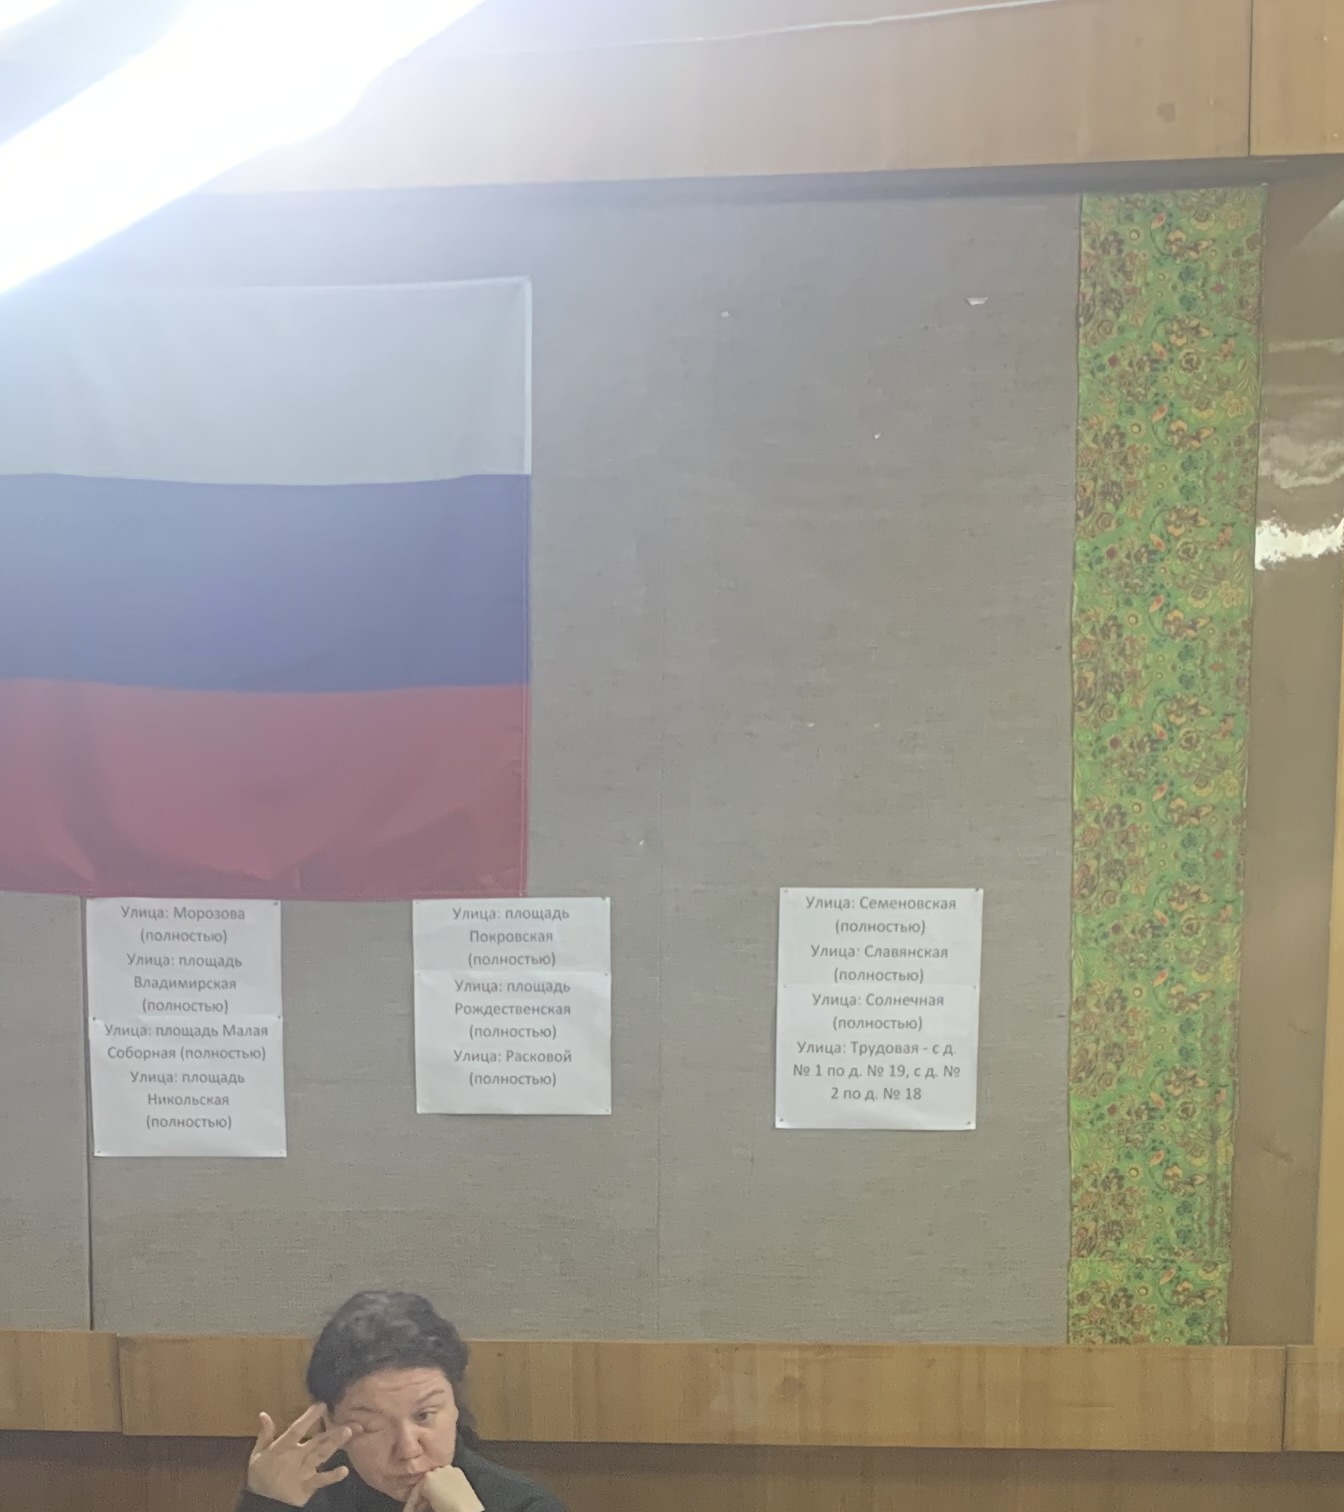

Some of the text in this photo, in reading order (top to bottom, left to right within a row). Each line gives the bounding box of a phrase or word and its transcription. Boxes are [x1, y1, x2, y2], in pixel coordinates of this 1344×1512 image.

[806, 896, 956, 911] Улица: Семеновская
[121, 906, 245, 922] Улица: Морозова
[452, 907, 570, 922] Улица: площадь
[835, 919, 926, 936] (полностью)
[140, 928, 227, 945] (полностью)
[469, 930, 553, 945] Покровская
[468, 951, 556, 968] (полностью)
[811, 945, 948, 960] Улица: Славянская
[127, 953, 242, 969] Улица: площадь
[834, 967, 924, 984] (полностью)
[134, 976, 236, 992] Владимирская
[454, 979, 571, 994] Улица: площадь
[142, 998, 228, 1015] (полностью)
[812, 993, 944, 1008] Улица: Солнечная
[455, 1002, 571, 1017] Рождественская
[104, 1022, 268, 1039] Улица: площадь Малая
[833, 1016, 923, 1032] (полностью)
[469, 1024, 557, 1040] (полностью)
[107, 1046, 266, 1061] Соборная (полностью)
[453, 1049, 572, 1064] Улица: Расковой
[797, 1041, 846, 1056] Улица:
[850, 1041, 919, 1057] Трудовая
[932, 1044, 939, 1055] с
[942, 1044, 956, 1057] д.
[130, 1071, 245, 1085] Улица: площадь
[793, 1064, 960, 1079] № 1 по д. № 19, с д. №
[469, 1072, 556, 1087] (полностью)
[148, 1093, 229, 1106] Никольская
[831, 1087, 922, 1102] 2 по д. № 18
[146, 1115, 232, 1130] (полностью)
